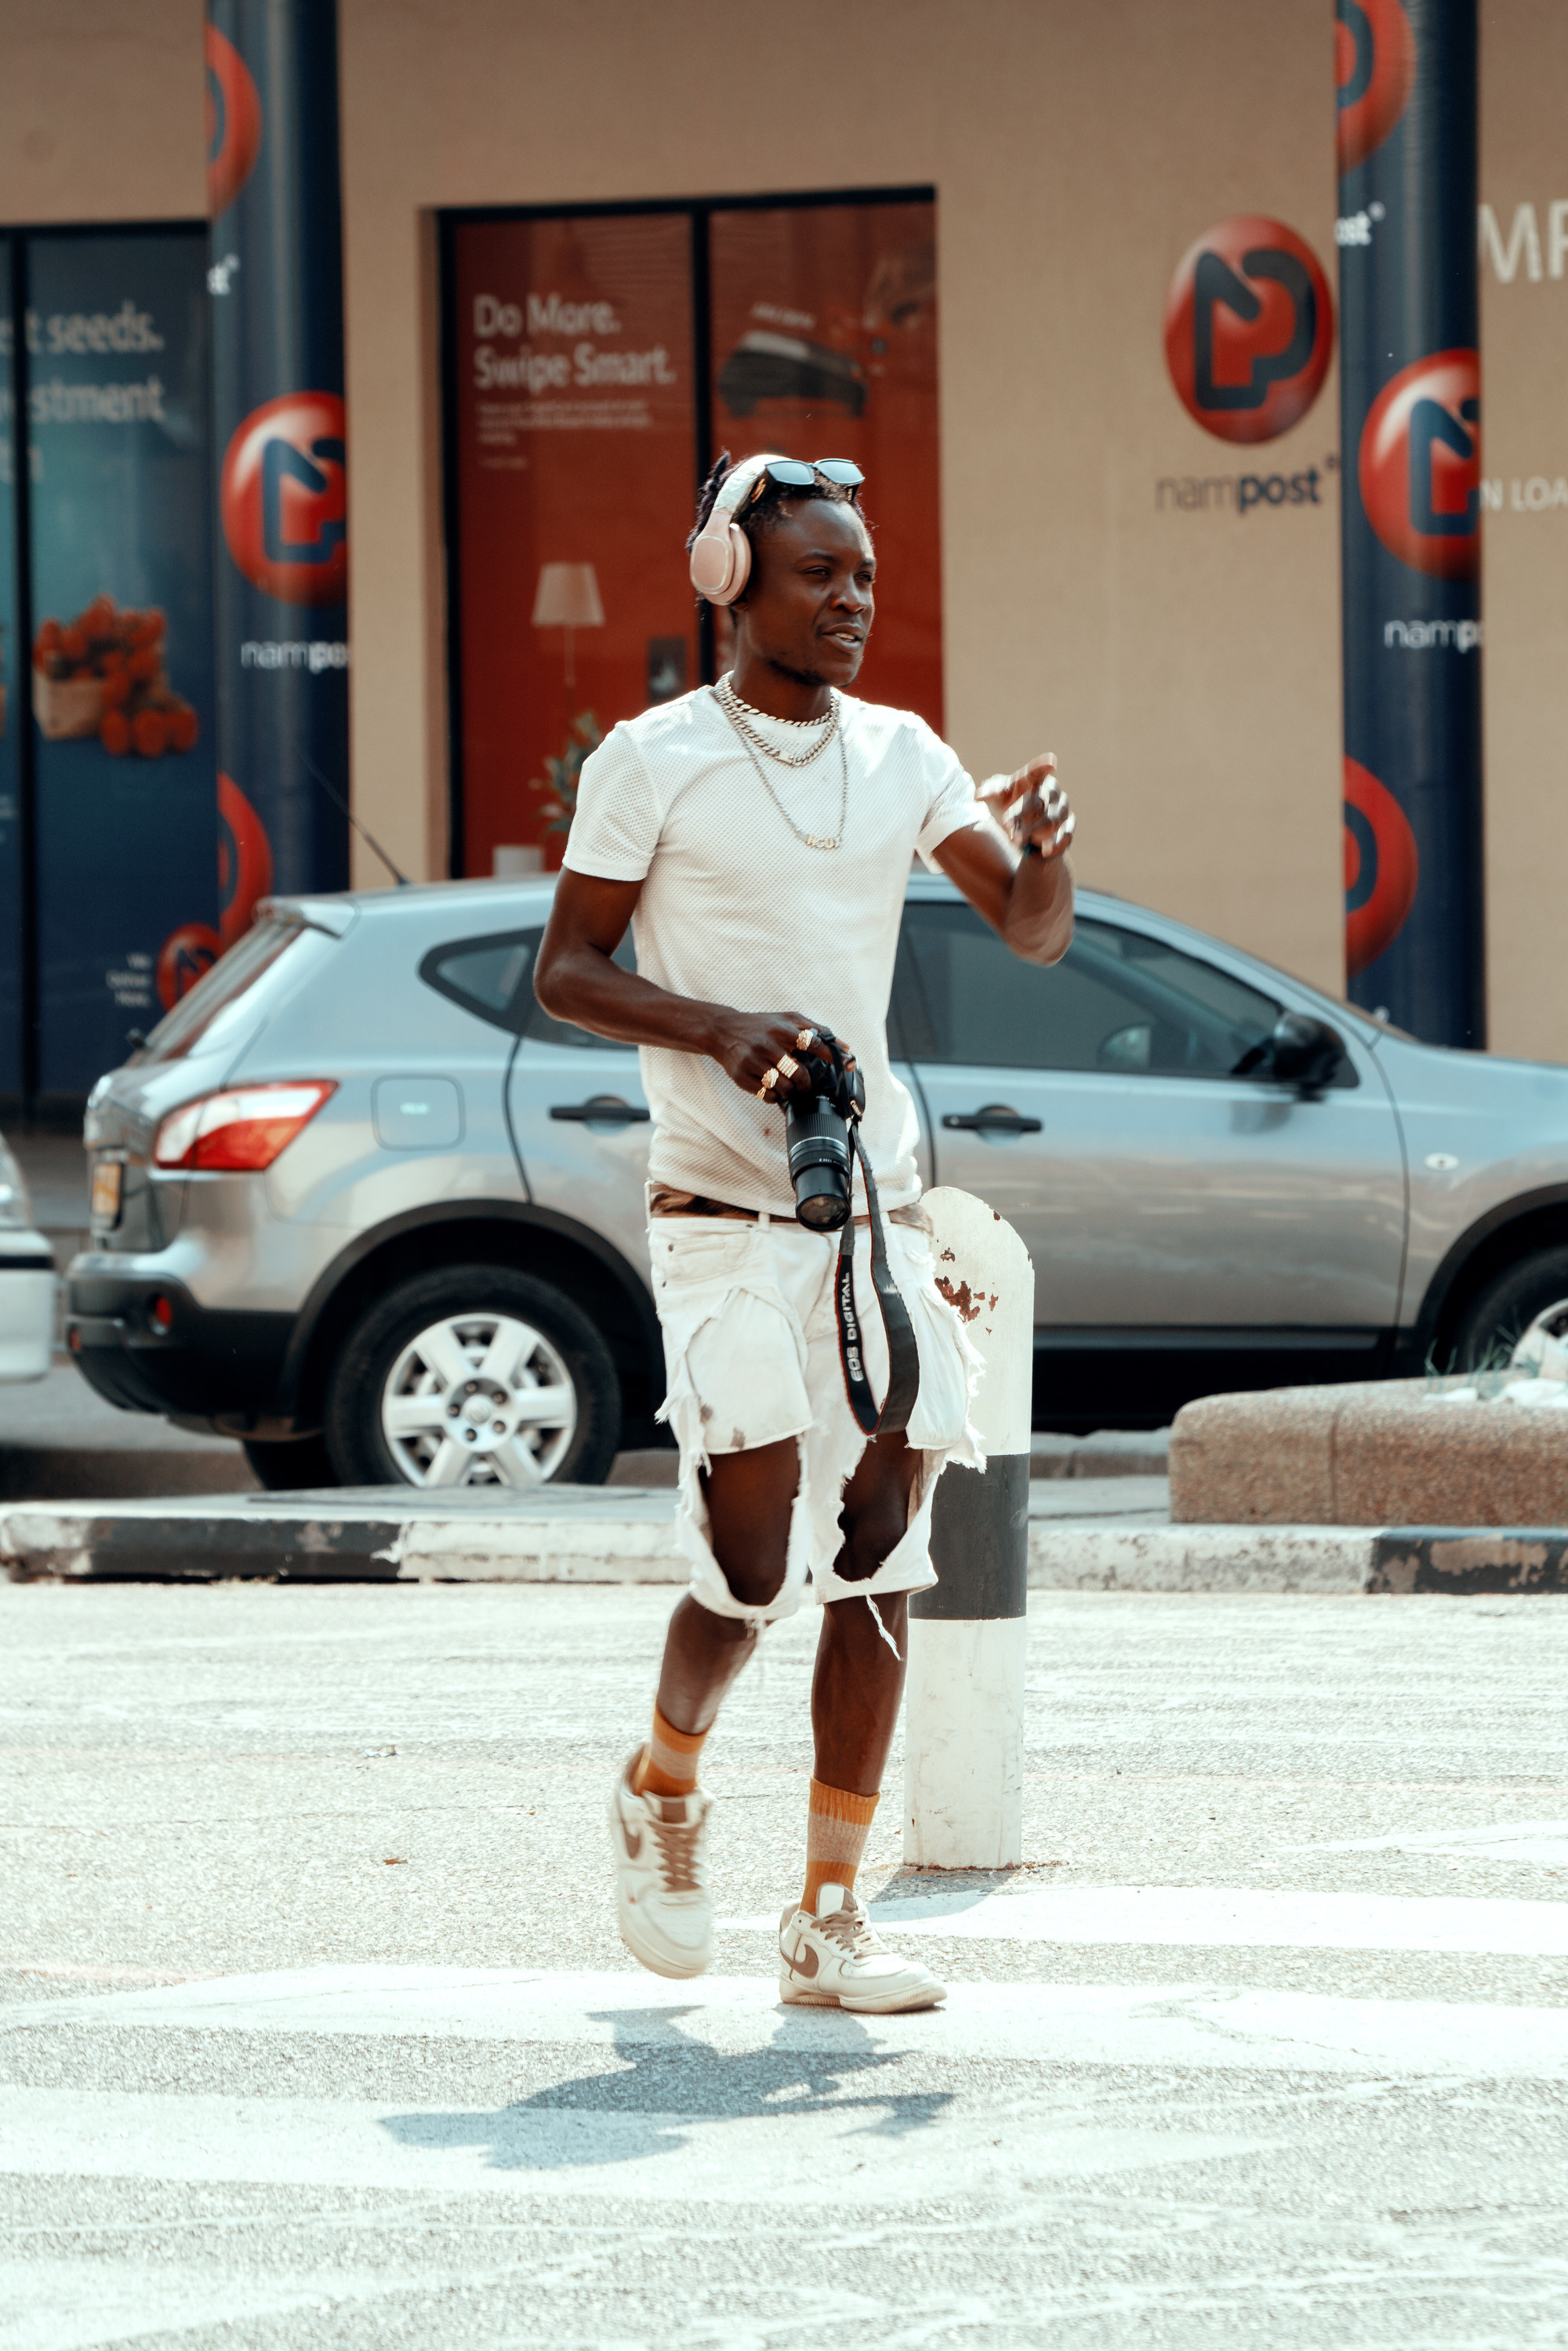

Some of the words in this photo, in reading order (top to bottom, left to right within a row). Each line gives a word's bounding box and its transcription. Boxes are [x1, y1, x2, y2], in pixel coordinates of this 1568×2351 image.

[47, 301, 164, 352] seeds.
[474, 293, 523, 338] Do
[526, 292, 621, 336] More.
[474, 345, 570, 394] Swipe
[574, 343, 676, 386] Smart.
[1156, 466, 1320, 516] nampost
[1385, 620, 1482, 654] namp
[841, 1272, 857, 1341] DIGITAL
[847, 1346, 864, 1381] EOS
